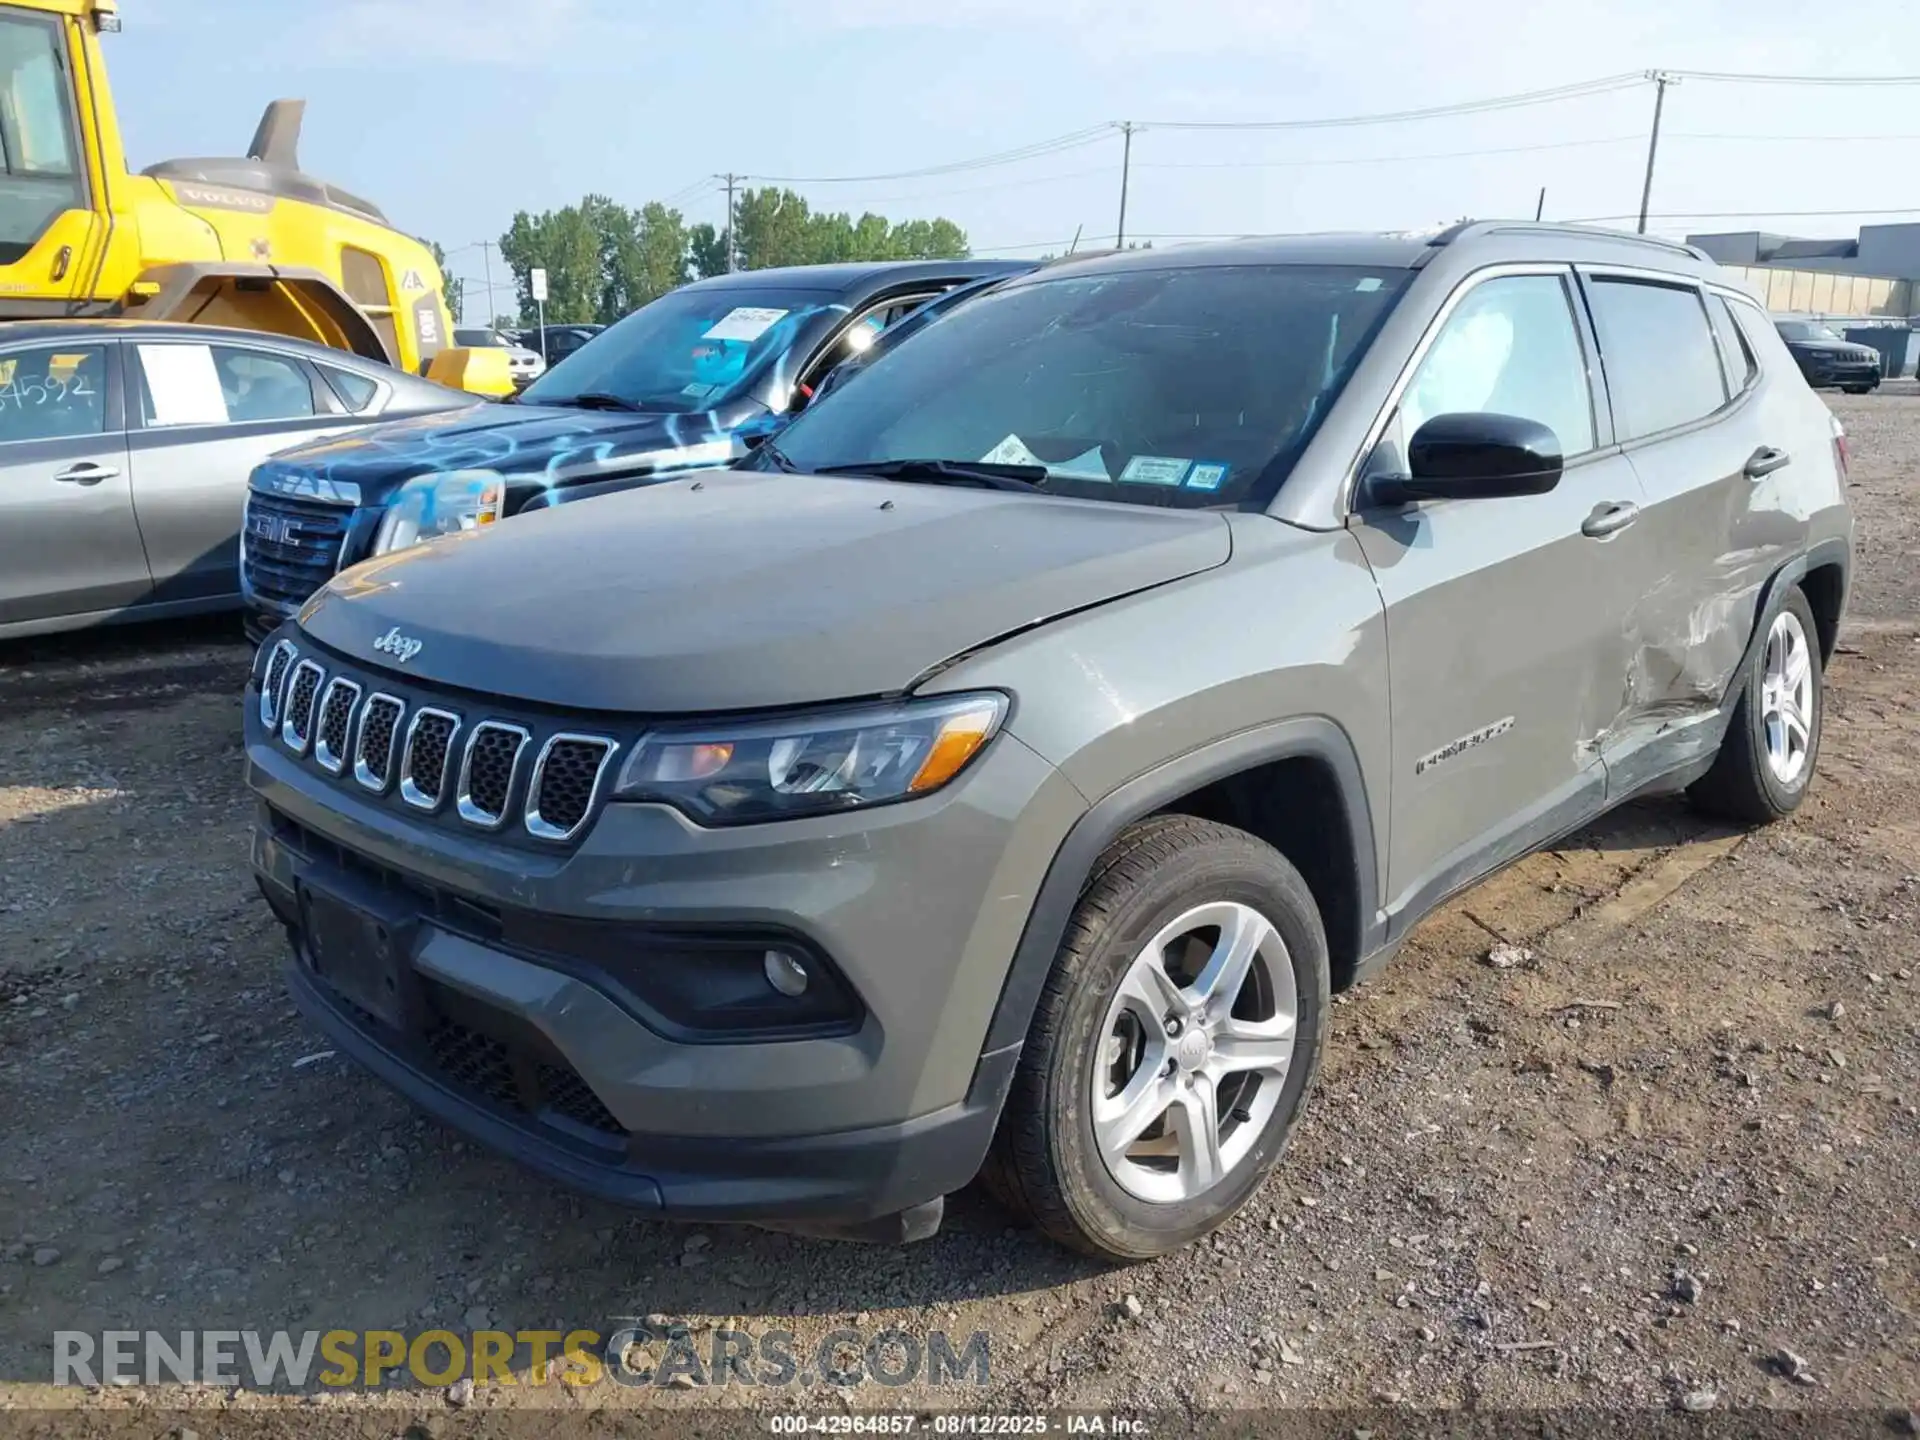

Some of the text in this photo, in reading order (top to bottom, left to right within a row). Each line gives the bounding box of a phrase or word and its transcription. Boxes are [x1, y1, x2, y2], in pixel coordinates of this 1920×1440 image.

[183, 189, 267, 208] VOLVO
[0, 374, 96, 410] 4592
[373, 626, 422, 663] Jeep
